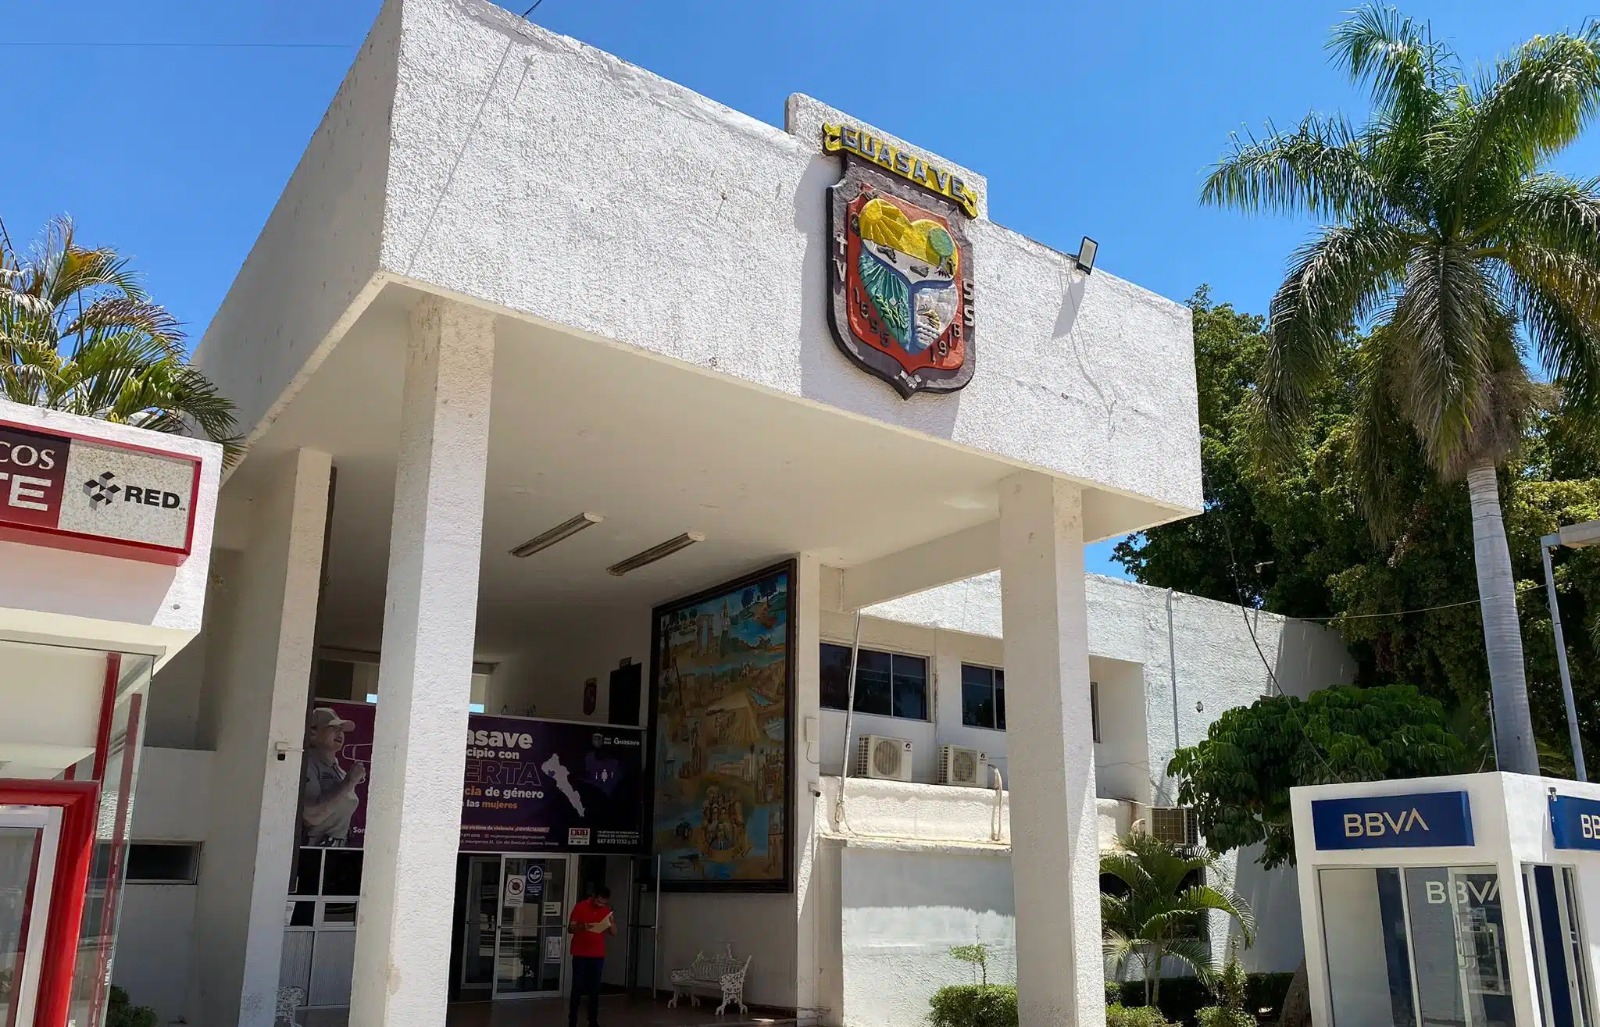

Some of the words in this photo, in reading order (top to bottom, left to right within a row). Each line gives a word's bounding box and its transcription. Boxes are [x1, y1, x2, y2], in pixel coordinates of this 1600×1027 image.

[841, 125, 966, 199] GUASAVE
[0, 471, 52, 512] E
[124, 485, 180, 509] RED
[498, 750, 520, 760] con
[466, 799, 480, 808] las
[482, 801, 518, 809] mujeres
[485, 787, 500, 797] de
[503, 788, 545, 799] género
[1344, 808, 1429, 837] BBVA
